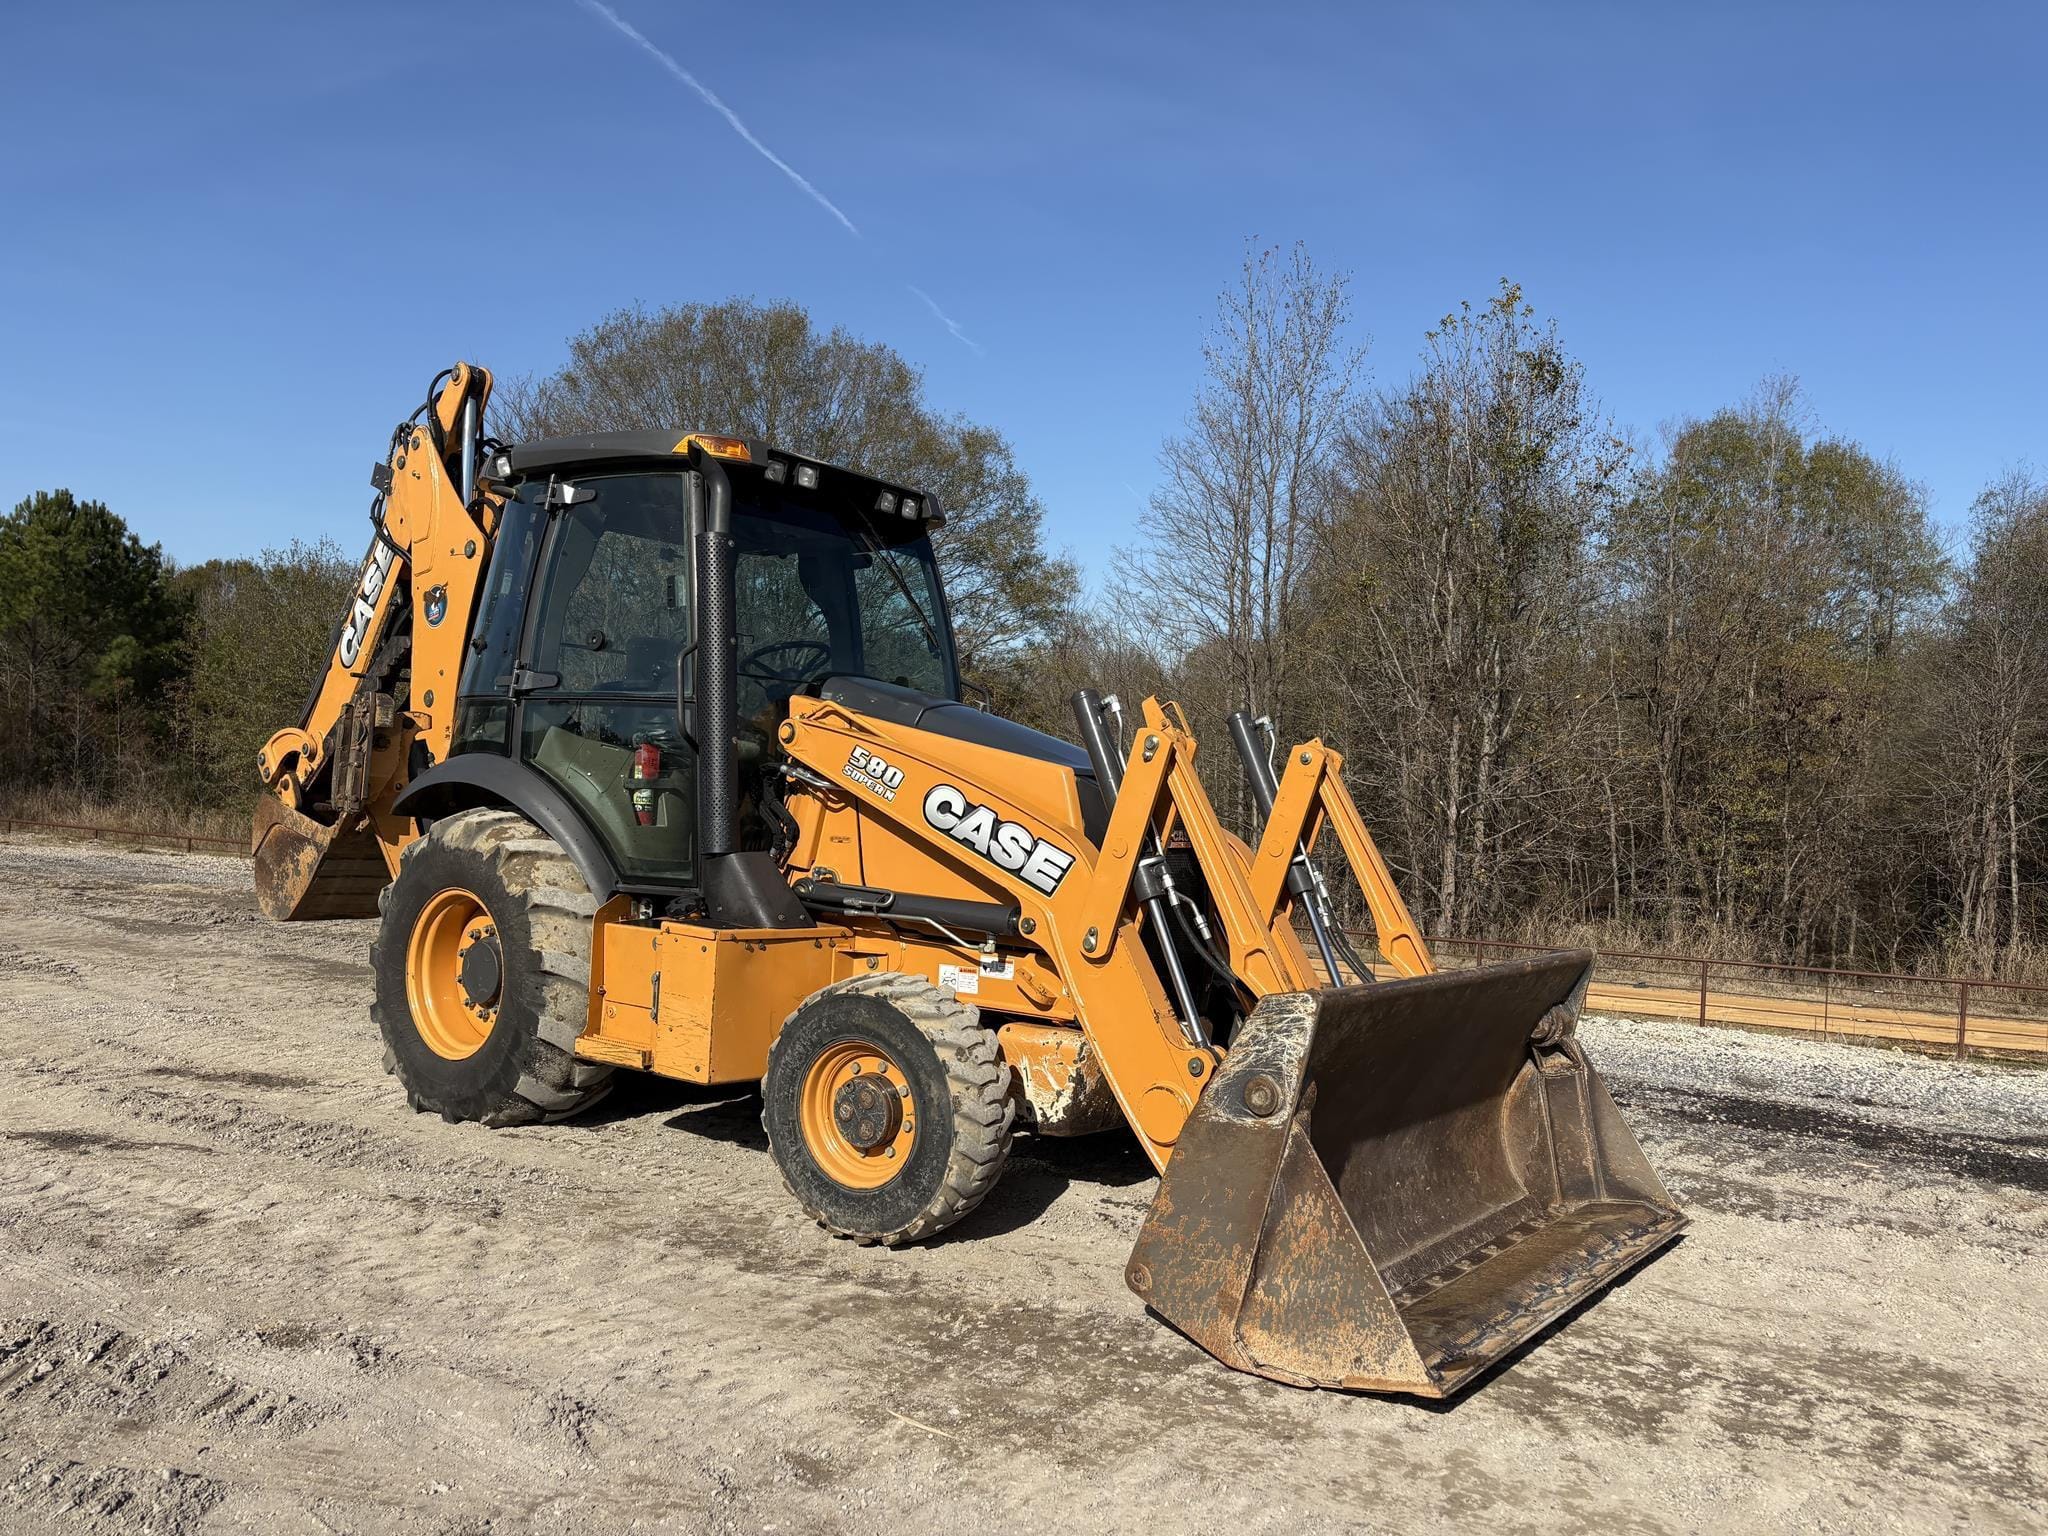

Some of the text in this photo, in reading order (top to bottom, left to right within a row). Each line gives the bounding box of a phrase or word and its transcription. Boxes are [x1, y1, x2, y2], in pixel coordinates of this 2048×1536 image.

[340, 526, 394, 668] CASE
[842, 764, 896, 802] SUPER N
[848, 745, 905, 789] 580
[923, 784, 1076, 896] CASE
